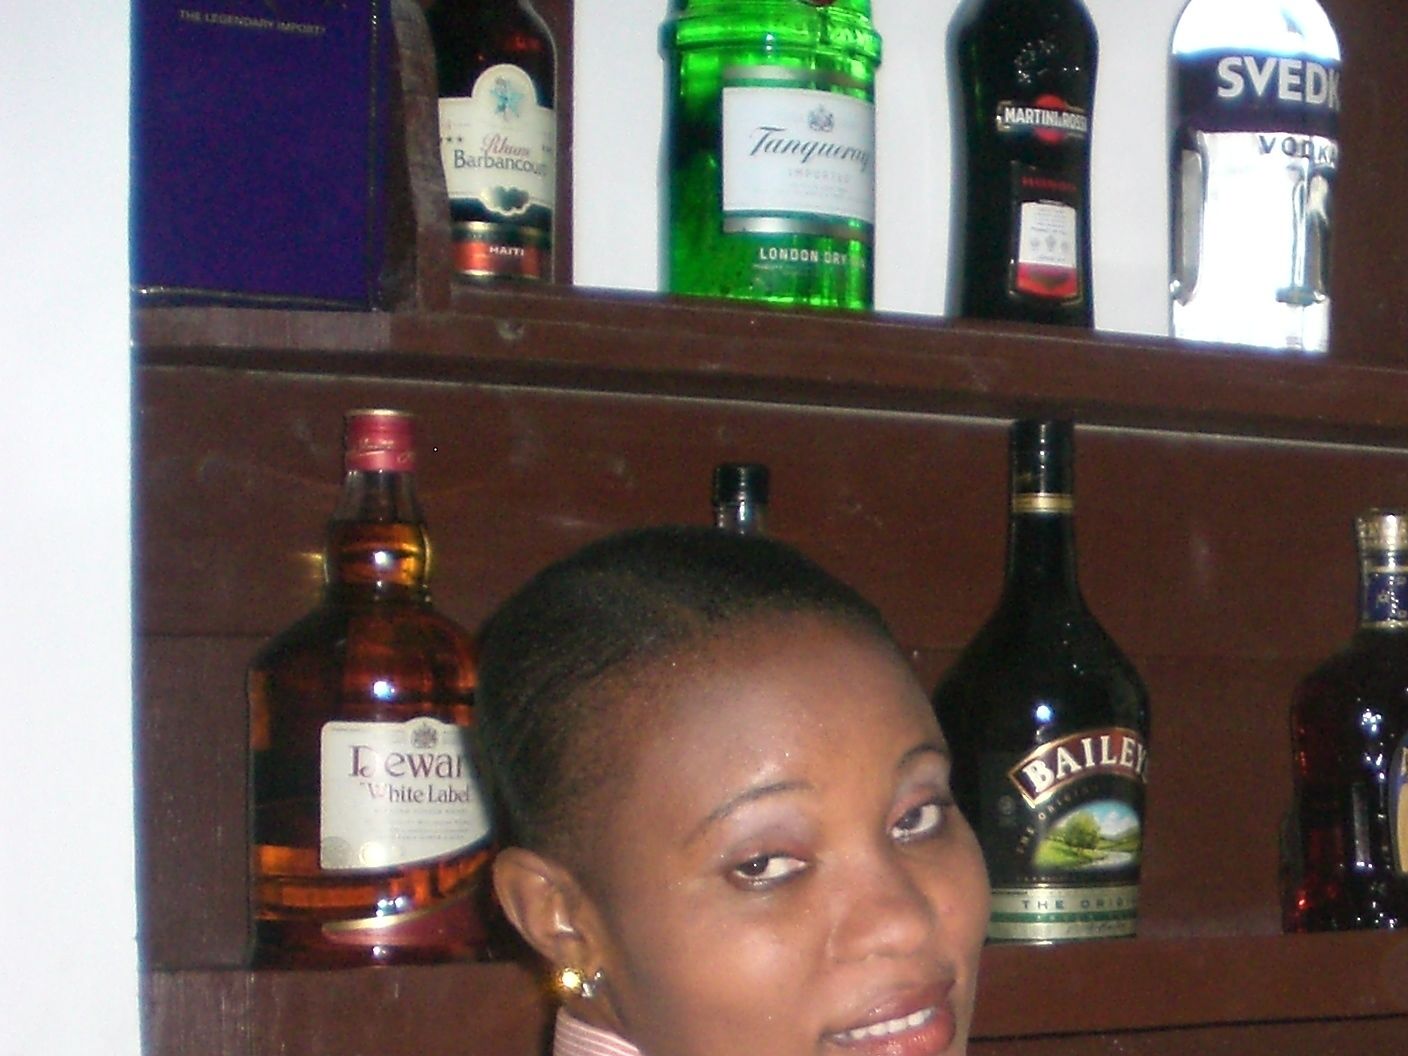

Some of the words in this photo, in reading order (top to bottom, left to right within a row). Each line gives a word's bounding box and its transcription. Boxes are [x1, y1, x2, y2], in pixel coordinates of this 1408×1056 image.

[489, 246, 524, 256] HAITI
[760, 247, 818, 262] LONDON
[428, 784, 470, 803] Label
[1022, 900, 1065, 910] THE
